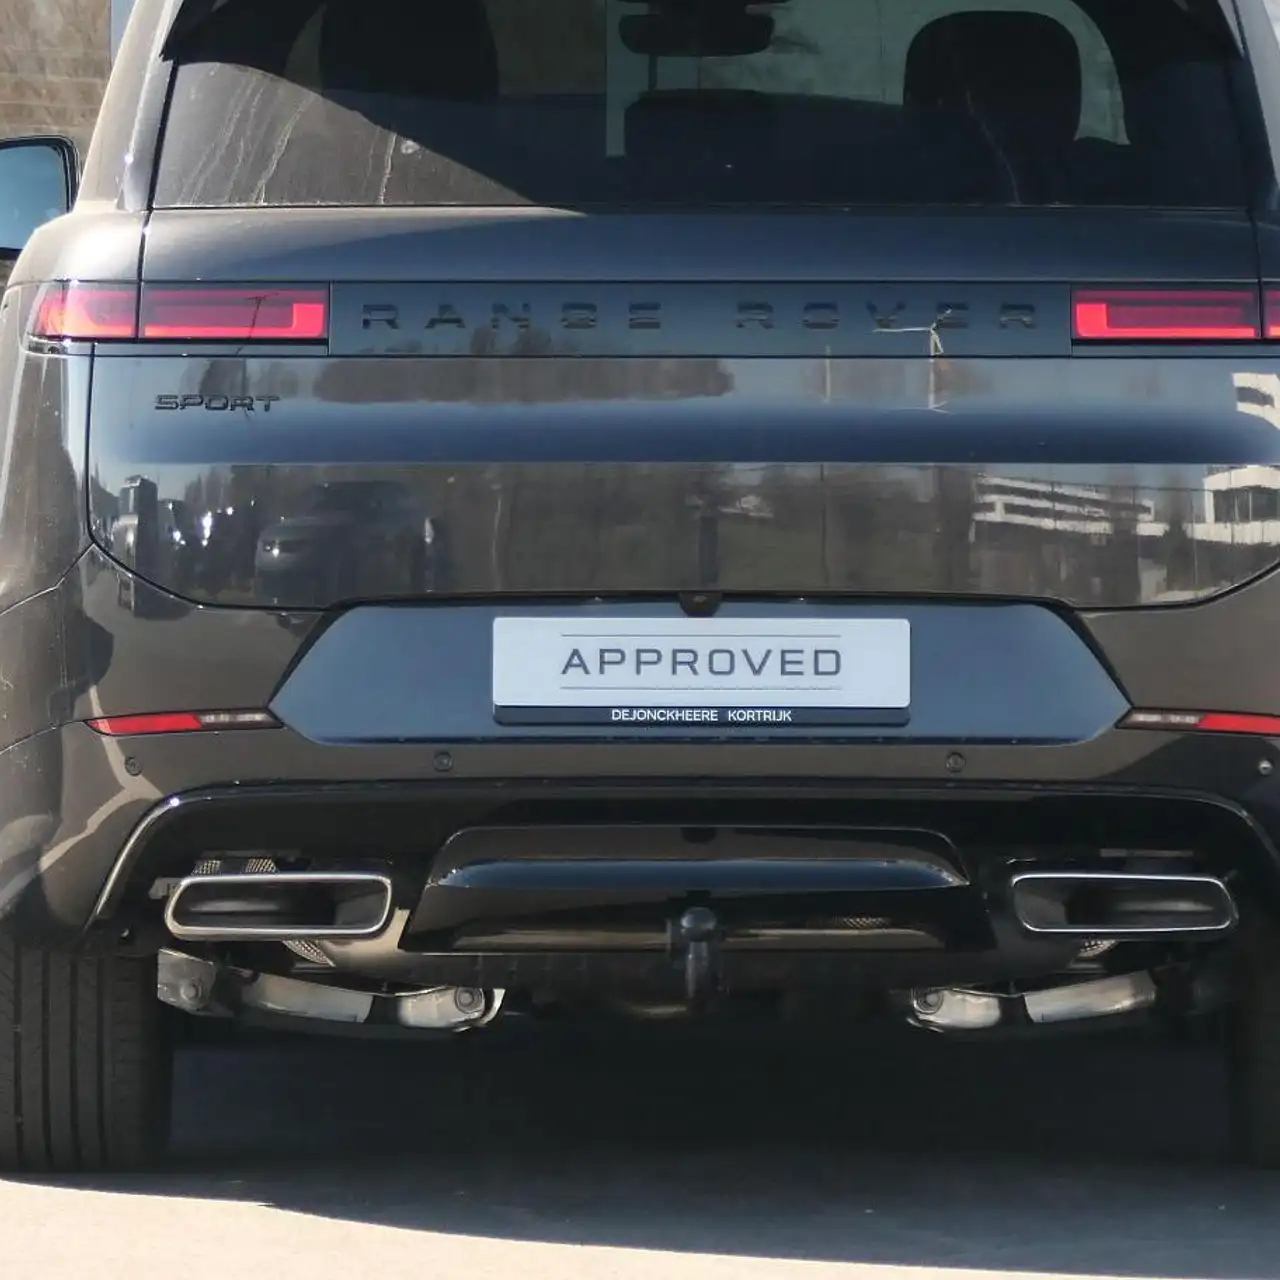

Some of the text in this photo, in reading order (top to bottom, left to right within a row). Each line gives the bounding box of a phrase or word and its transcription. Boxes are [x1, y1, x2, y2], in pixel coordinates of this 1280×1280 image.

[362, 302, 1037, 330] RANGE ROVER
[154, 394, 280, 412] SPORT
[561, 648, 842, 677] APPROVED
[611, 708, 793, 723] DEJONCKHEERE KORTRIJK
